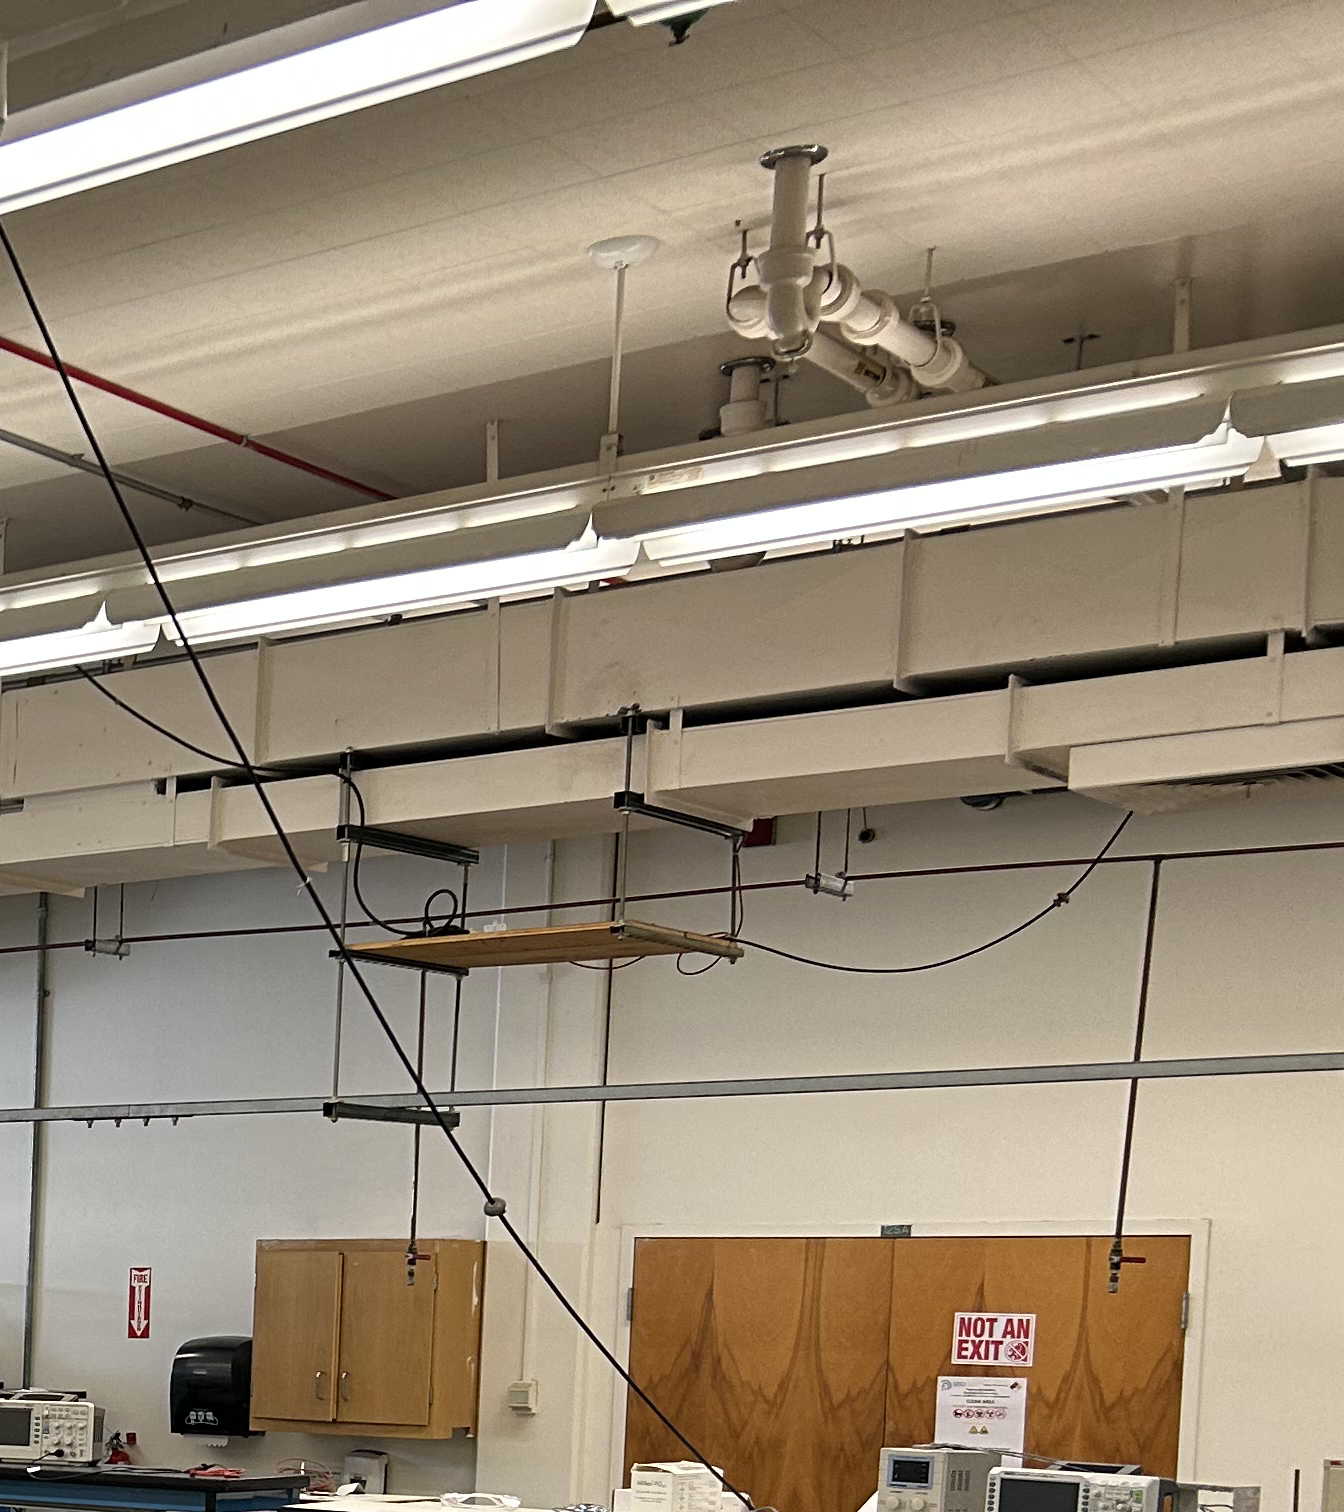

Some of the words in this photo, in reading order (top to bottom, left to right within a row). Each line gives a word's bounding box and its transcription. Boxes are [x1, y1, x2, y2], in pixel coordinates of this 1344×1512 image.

[134, 1274, 147, 1283] FIRE
[958, 1317, 998, 1339] NOT
[1001, 1318, 1031, 1340] AN
[957, 1339, 1004, 1361] EXIT
